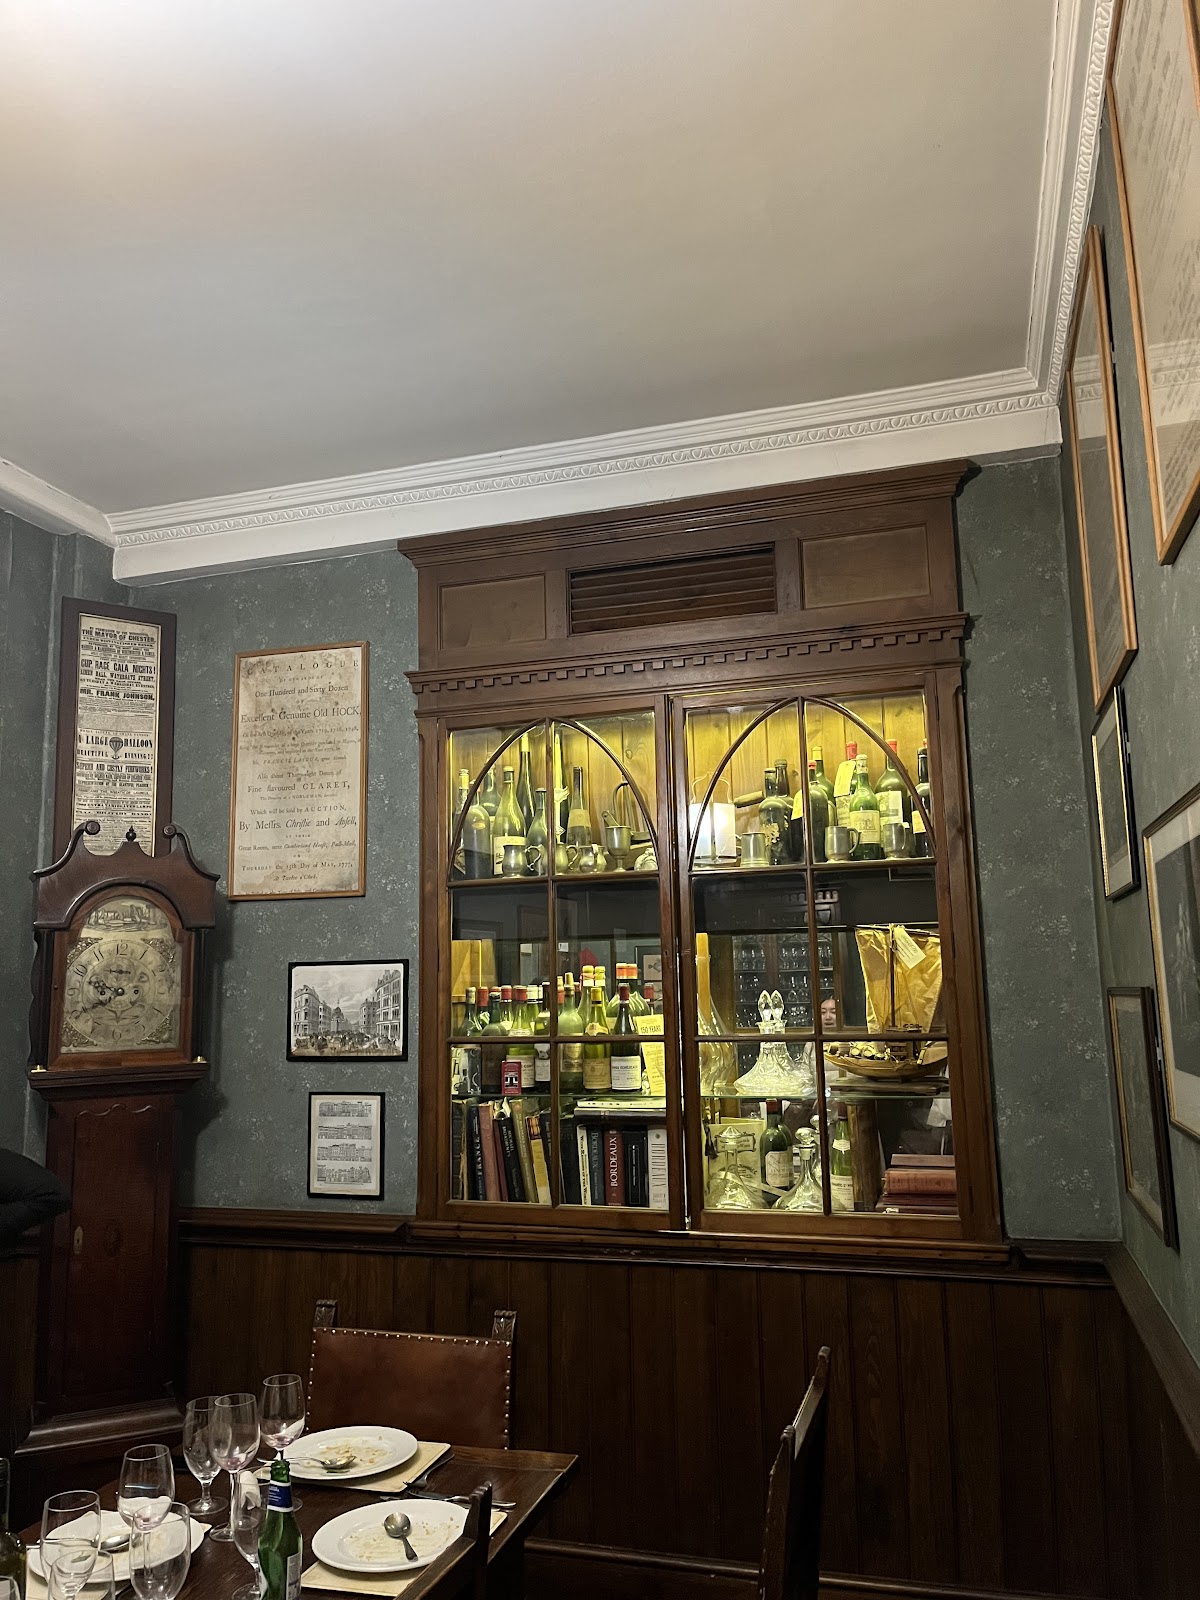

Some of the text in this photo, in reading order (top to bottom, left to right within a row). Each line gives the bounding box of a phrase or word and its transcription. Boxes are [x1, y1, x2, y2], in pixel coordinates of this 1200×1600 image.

[95, 631, 117, 639] MAYOR
[81, 659, 92, 668] CUP
[95, 661, 109, 670] RACE
[114, 663, 128, 672] GALA
[247, 660, 359, 675] CATALOGUE
[269, 688, 296, 697] Hundred
[309, 685, 325, 695] Sixty
[241, 714, 275, 723] Excellent
[279, 711, 311, 721] Genuine
[314, 709, 328, 718] Old
[86, 736, 108, 746] LARGE
[124, 738, 153, 748] BALLOON
[239, 821, 251, 832] By
[316, 818, 330, 826] and
[116, 943, 128, 956] 12
[610, 1137, 618, 1187] BORDEAUX
[651, 1144, 666, 1187] BORDEAUX
